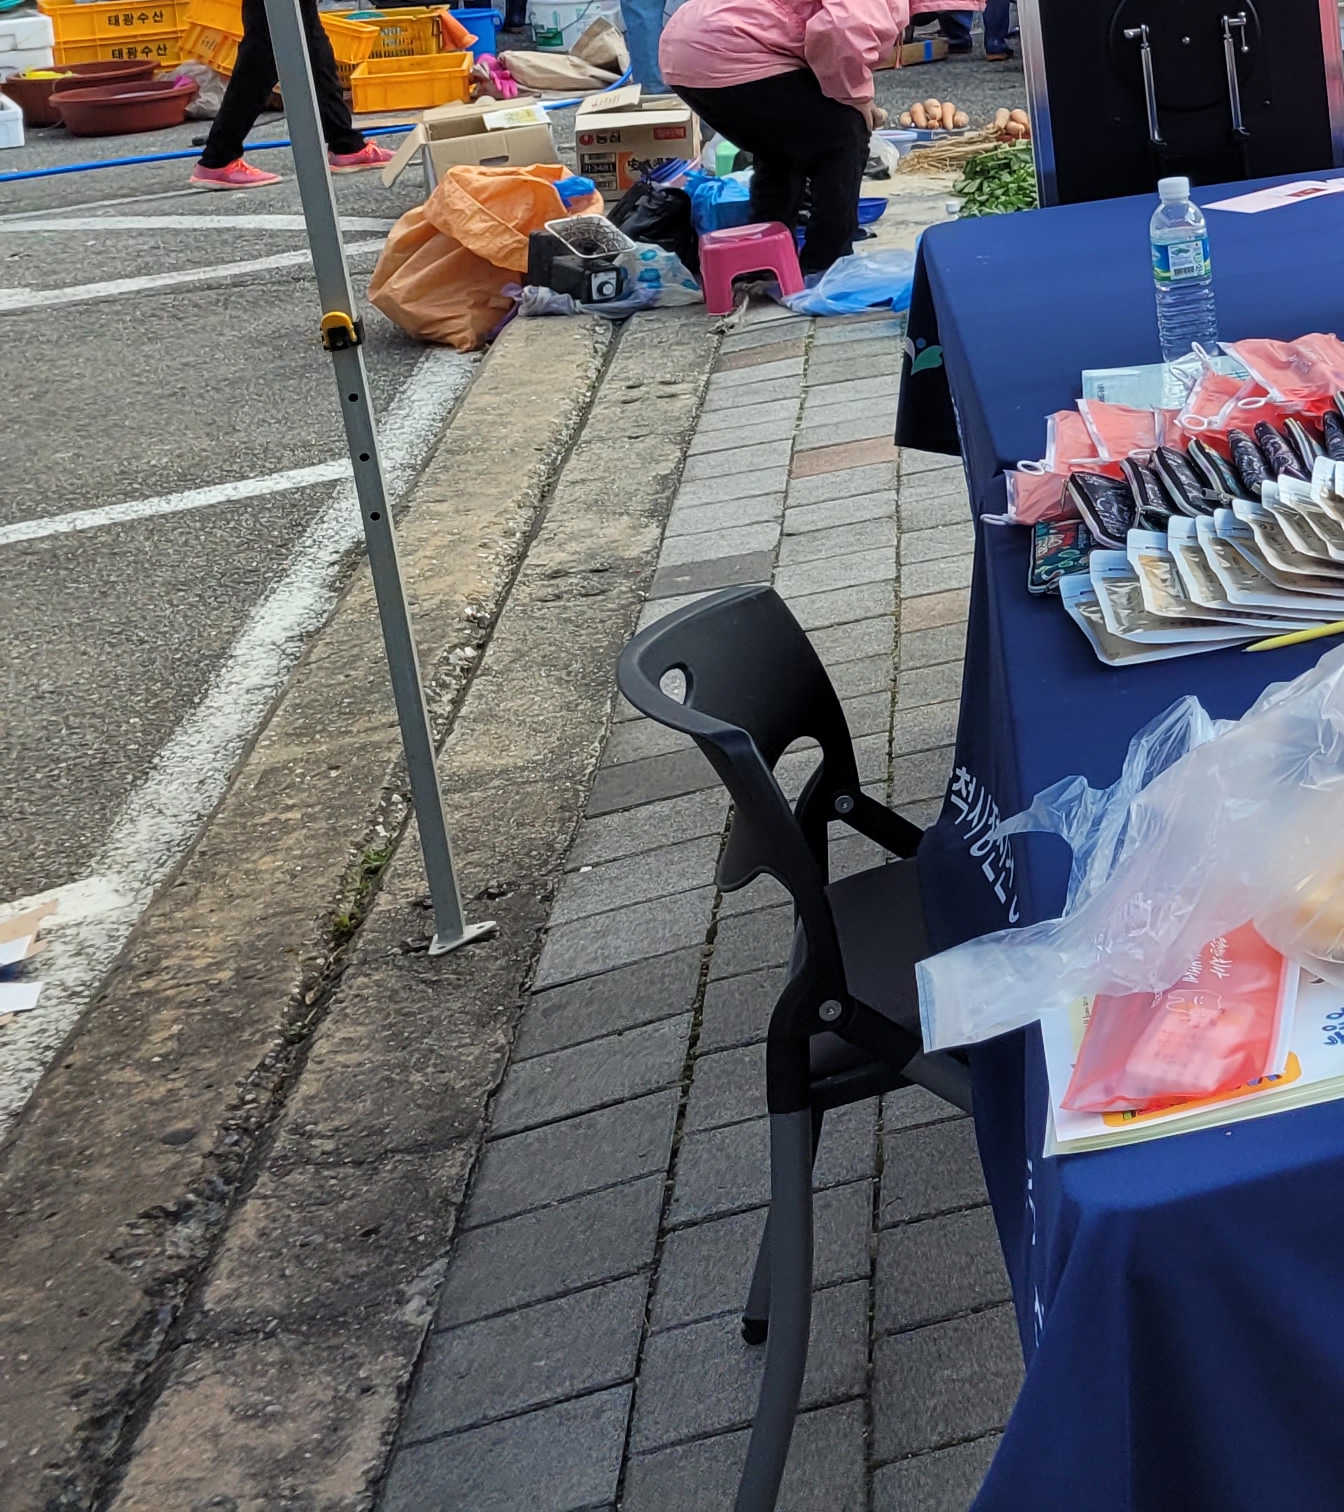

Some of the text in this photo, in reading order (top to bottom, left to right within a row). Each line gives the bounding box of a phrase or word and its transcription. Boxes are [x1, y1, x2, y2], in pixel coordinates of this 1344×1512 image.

[107, 10, 165, 27] 태광수산
[111, 43, 169, 60] 태광수산
[595, 129, 622, 144] 농심
